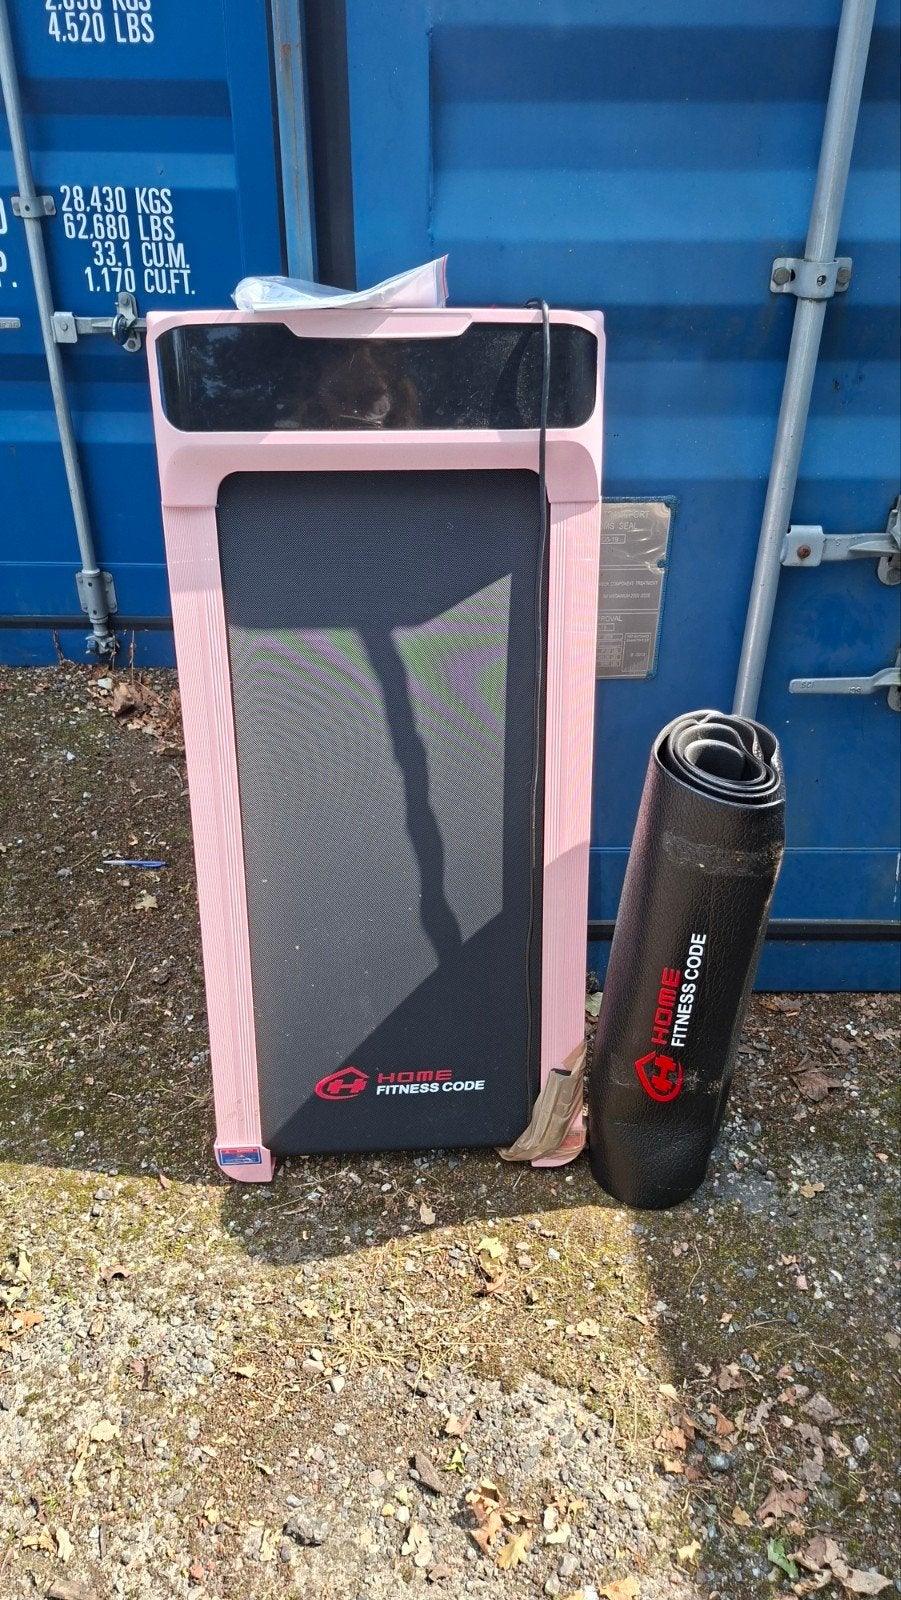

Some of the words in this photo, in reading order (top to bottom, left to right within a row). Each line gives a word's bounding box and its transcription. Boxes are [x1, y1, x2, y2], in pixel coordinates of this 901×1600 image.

[114, 12, 155, 43] LBS
[135, 187, 173, 215] KGS
[139, 214, 176, 241] LBS
[92, 240, 132, 267] 33.1
[141, 242, 190, 269] CU.M.
[144, 268, 196, 295] CU.FT.
[670, 983, 697, 1047] FITNESS
[684, 933, 707, 980] CODE
[650, 967, 681, 1045] HOME
[376, 1083, 439, 1096] FITNESS
[441, 1080, 486, 1092] CODE
[377, 1069, 453, 1084] HOME
